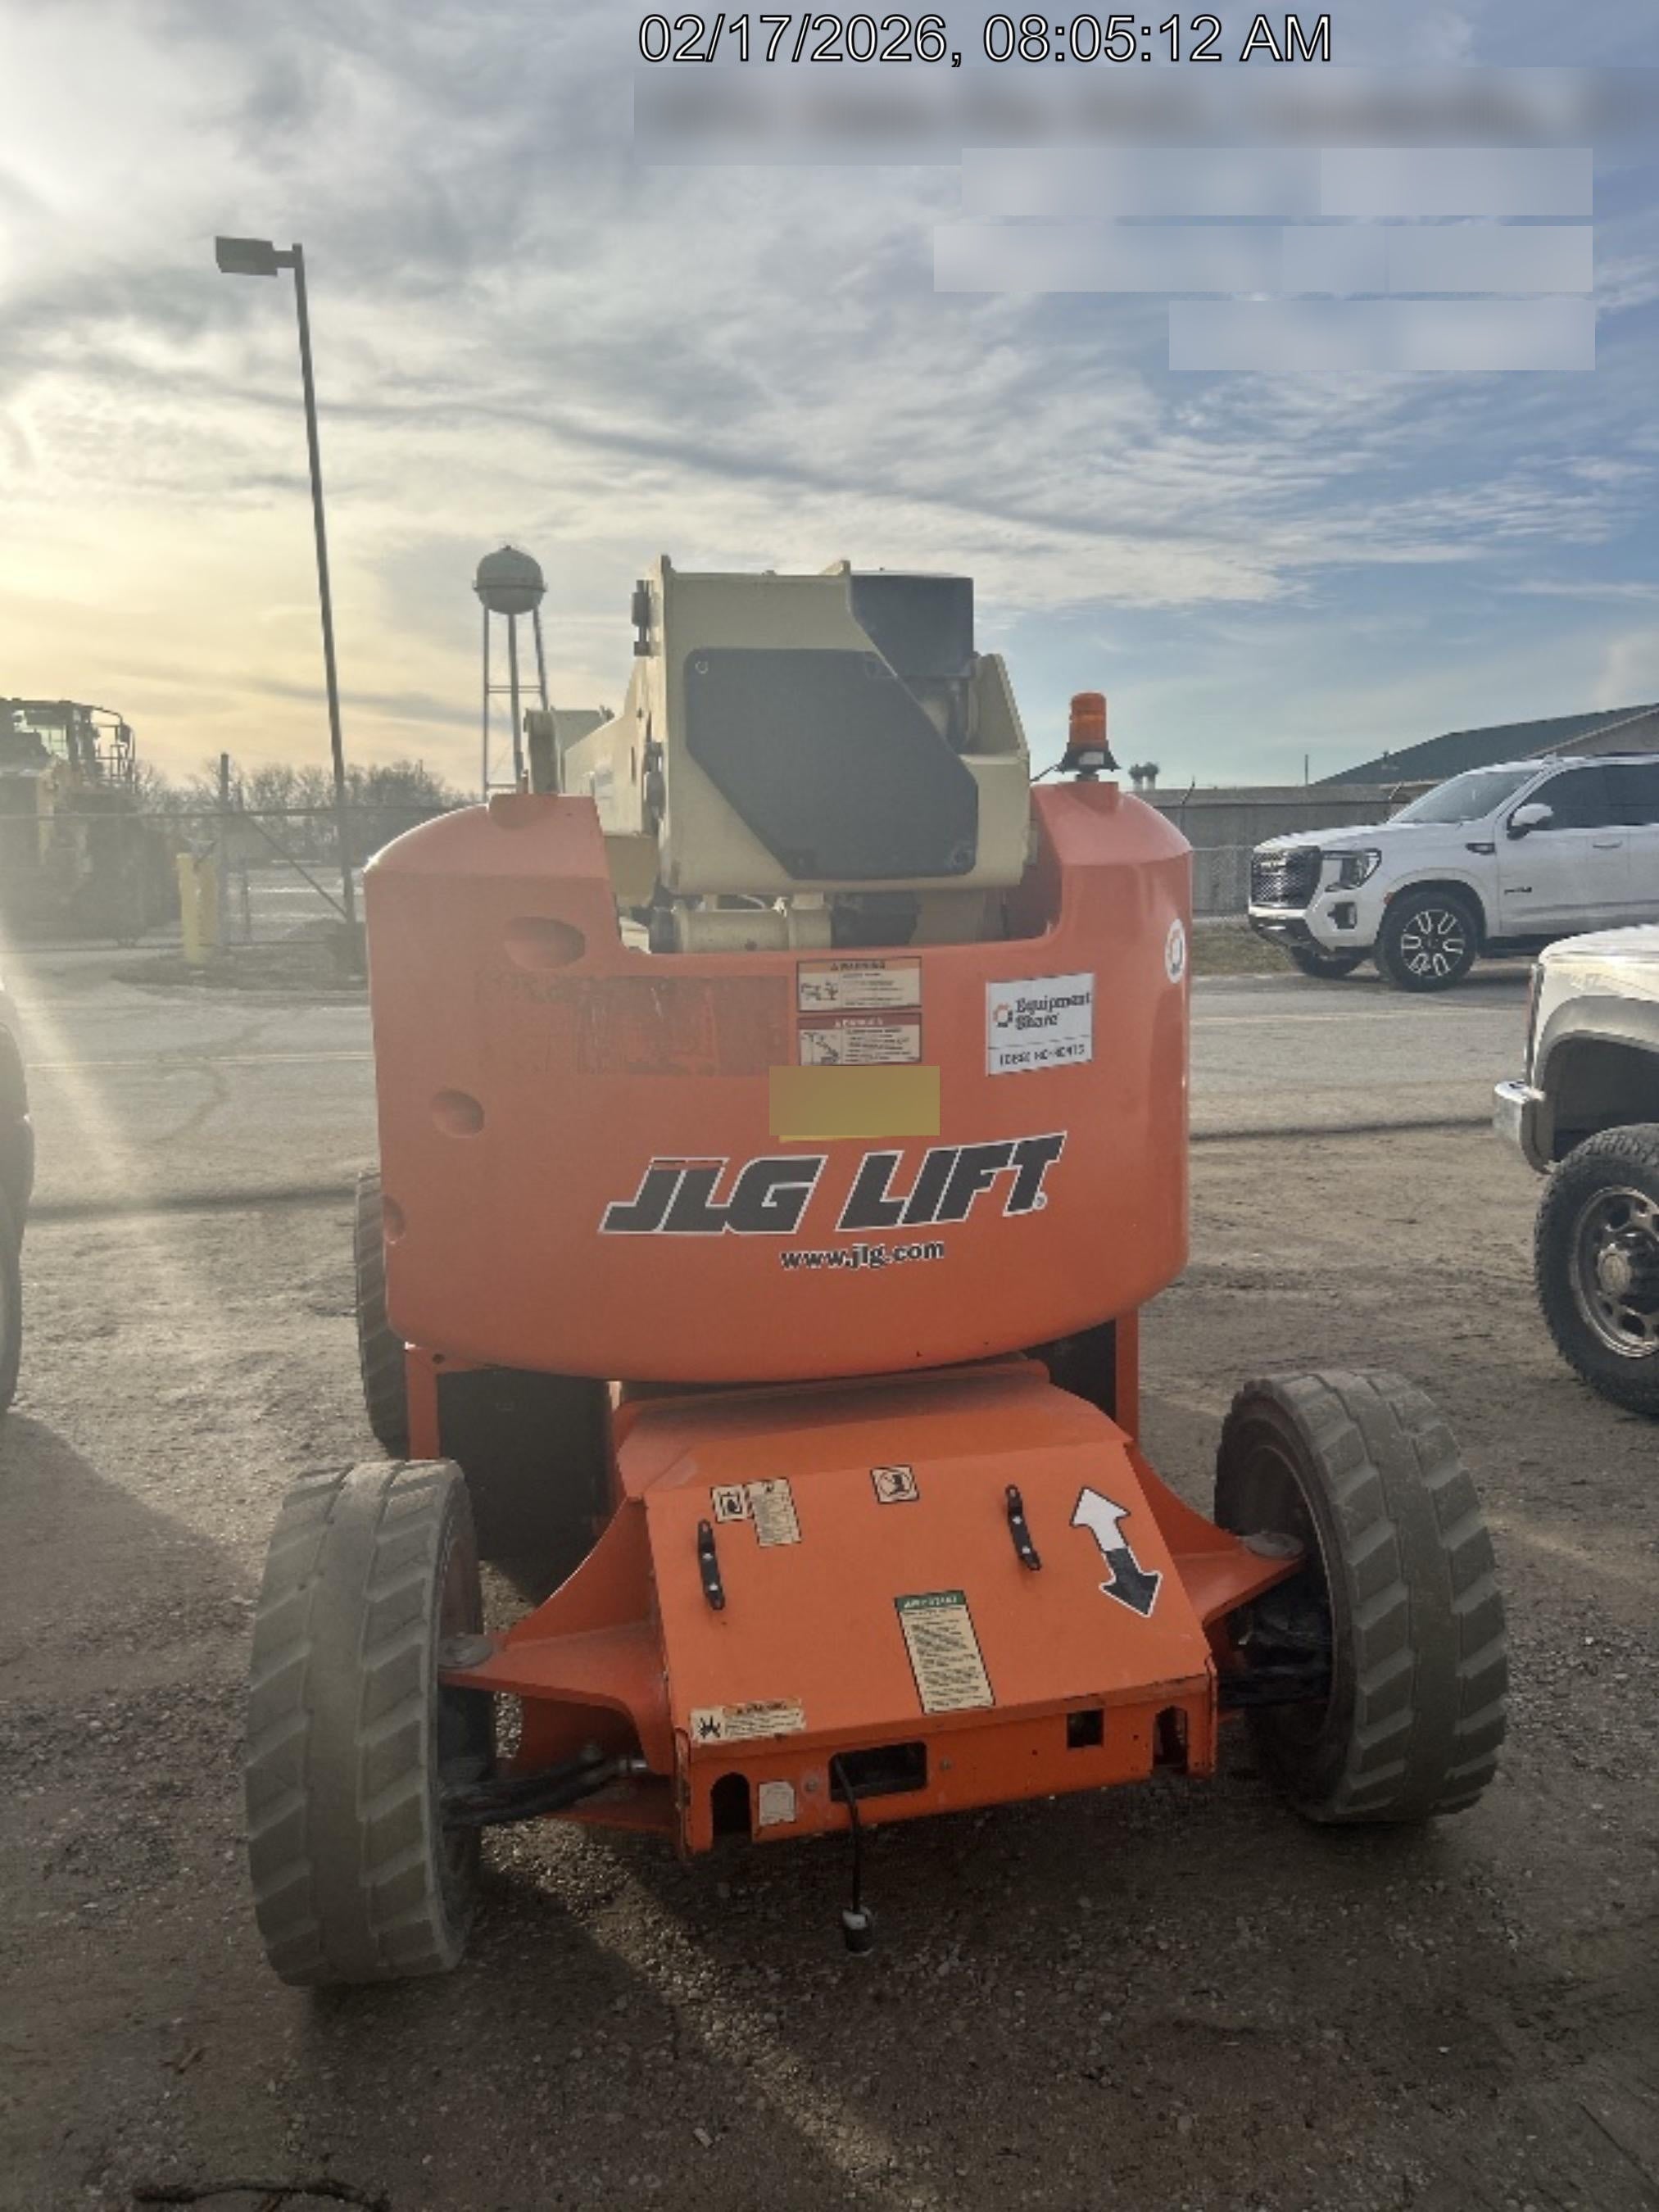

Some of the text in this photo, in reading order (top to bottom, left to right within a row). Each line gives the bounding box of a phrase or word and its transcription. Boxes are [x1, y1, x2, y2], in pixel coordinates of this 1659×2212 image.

[598, 1131, 1067, 1235] JLG LIFT
[781, 1240, 945, 1271] www.jlg.com
